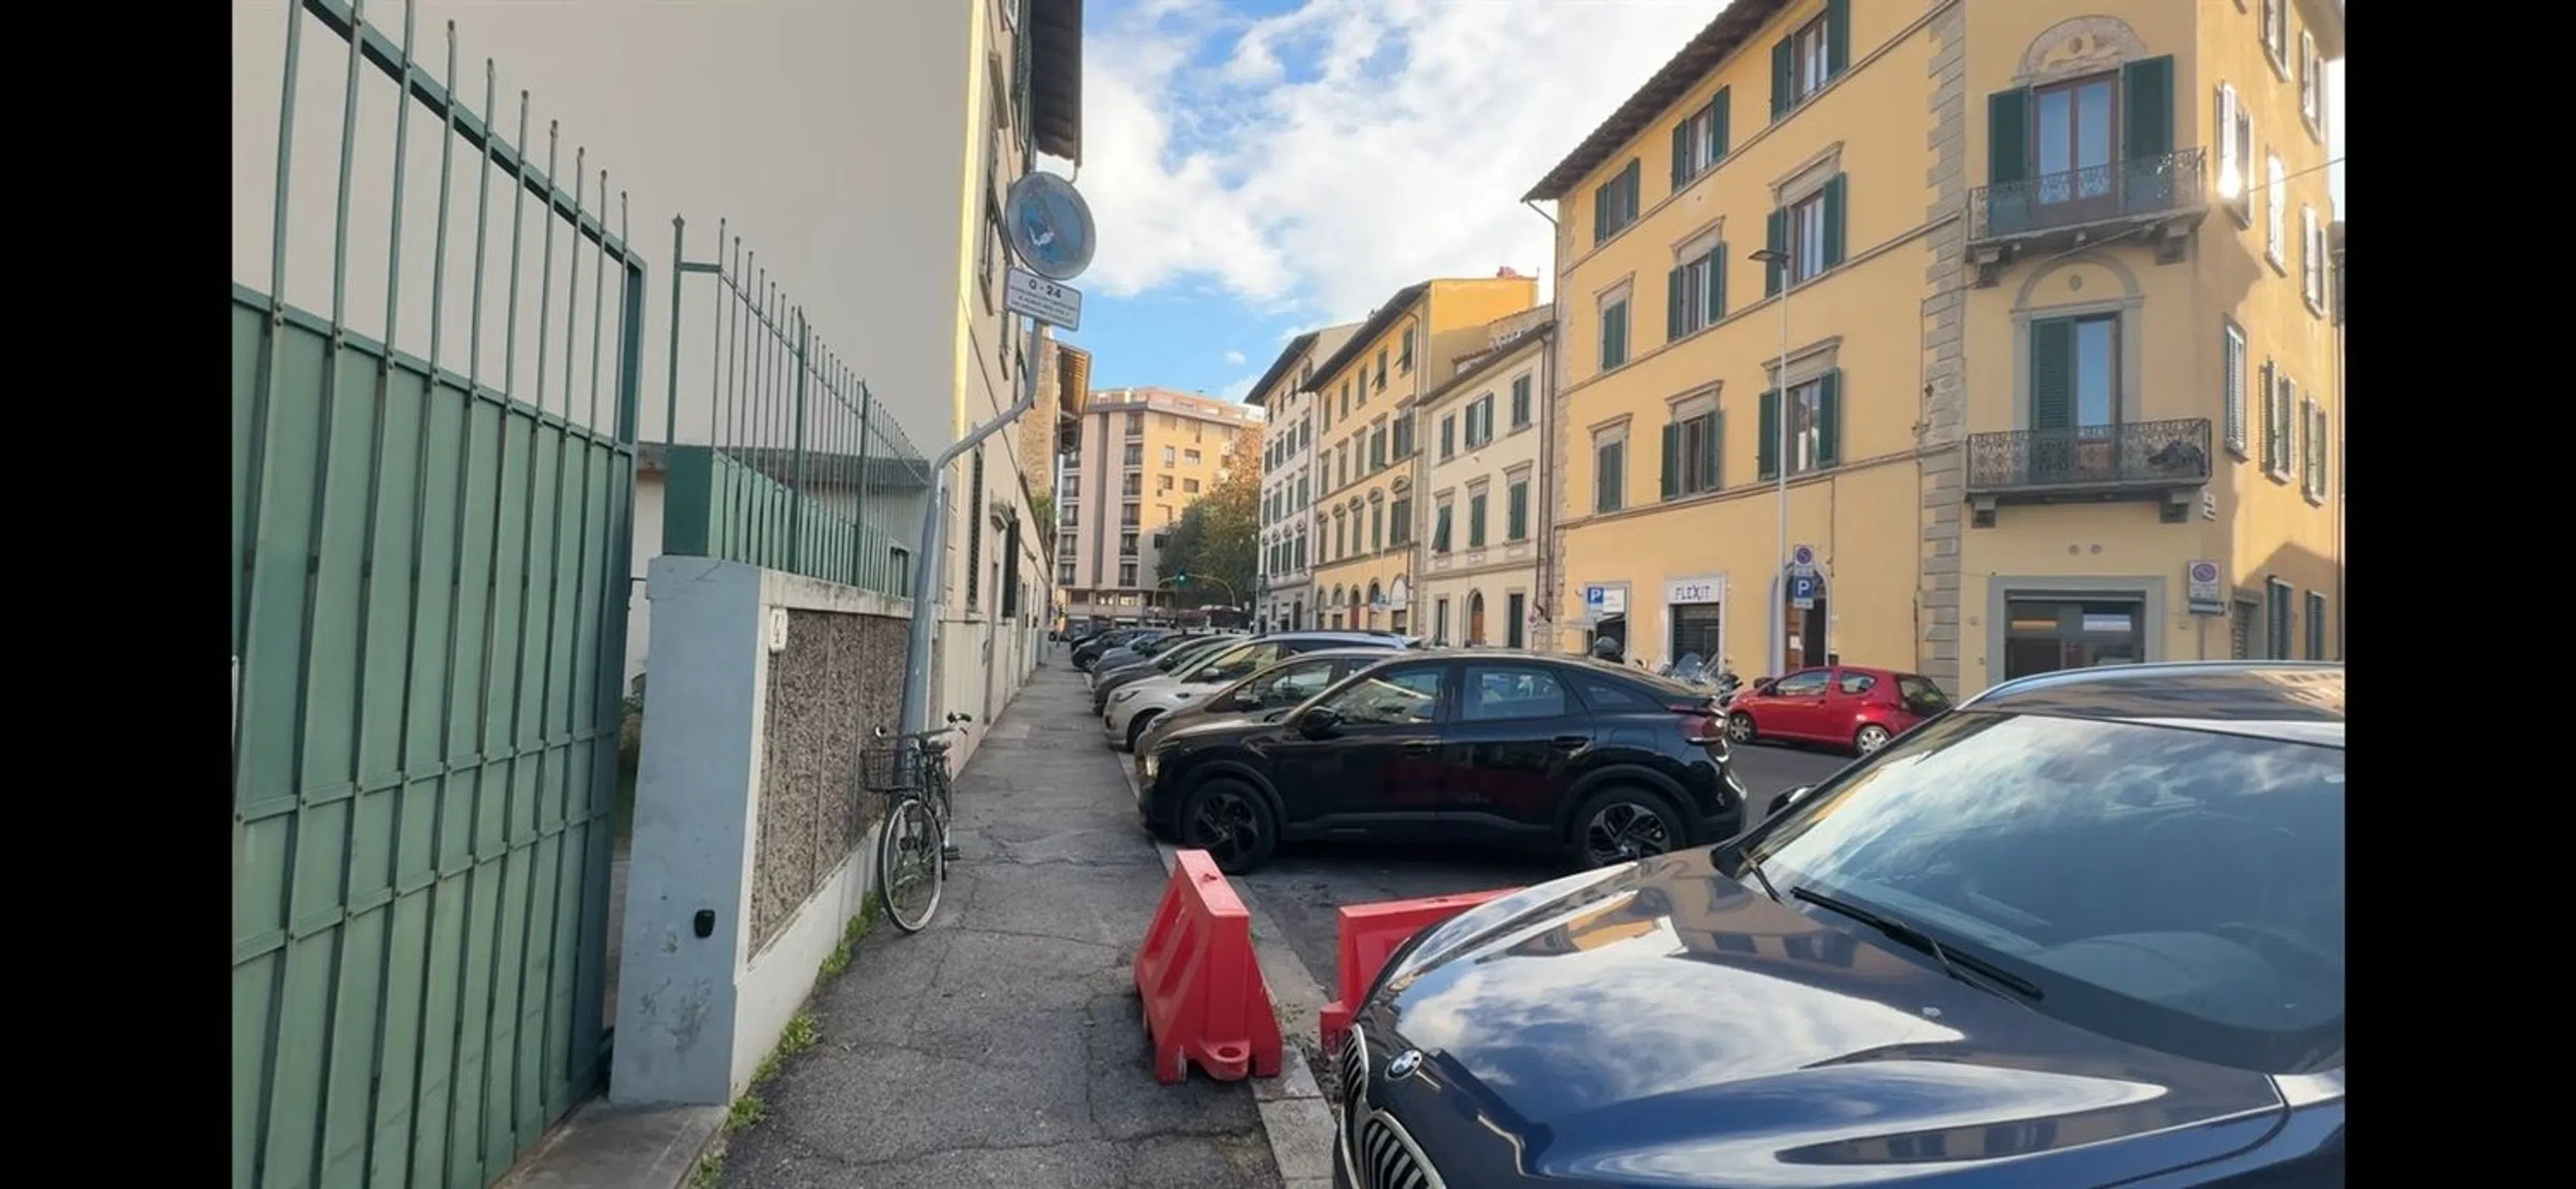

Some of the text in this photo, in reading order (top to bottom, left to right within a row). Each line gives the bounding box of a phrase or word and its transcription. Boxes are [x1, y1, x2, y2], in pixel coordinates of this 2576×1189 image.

[1047, 285, 1061, 298] 24
[1798, 579, 1810, 596] P
[1590, 589, 1601, 602] P
